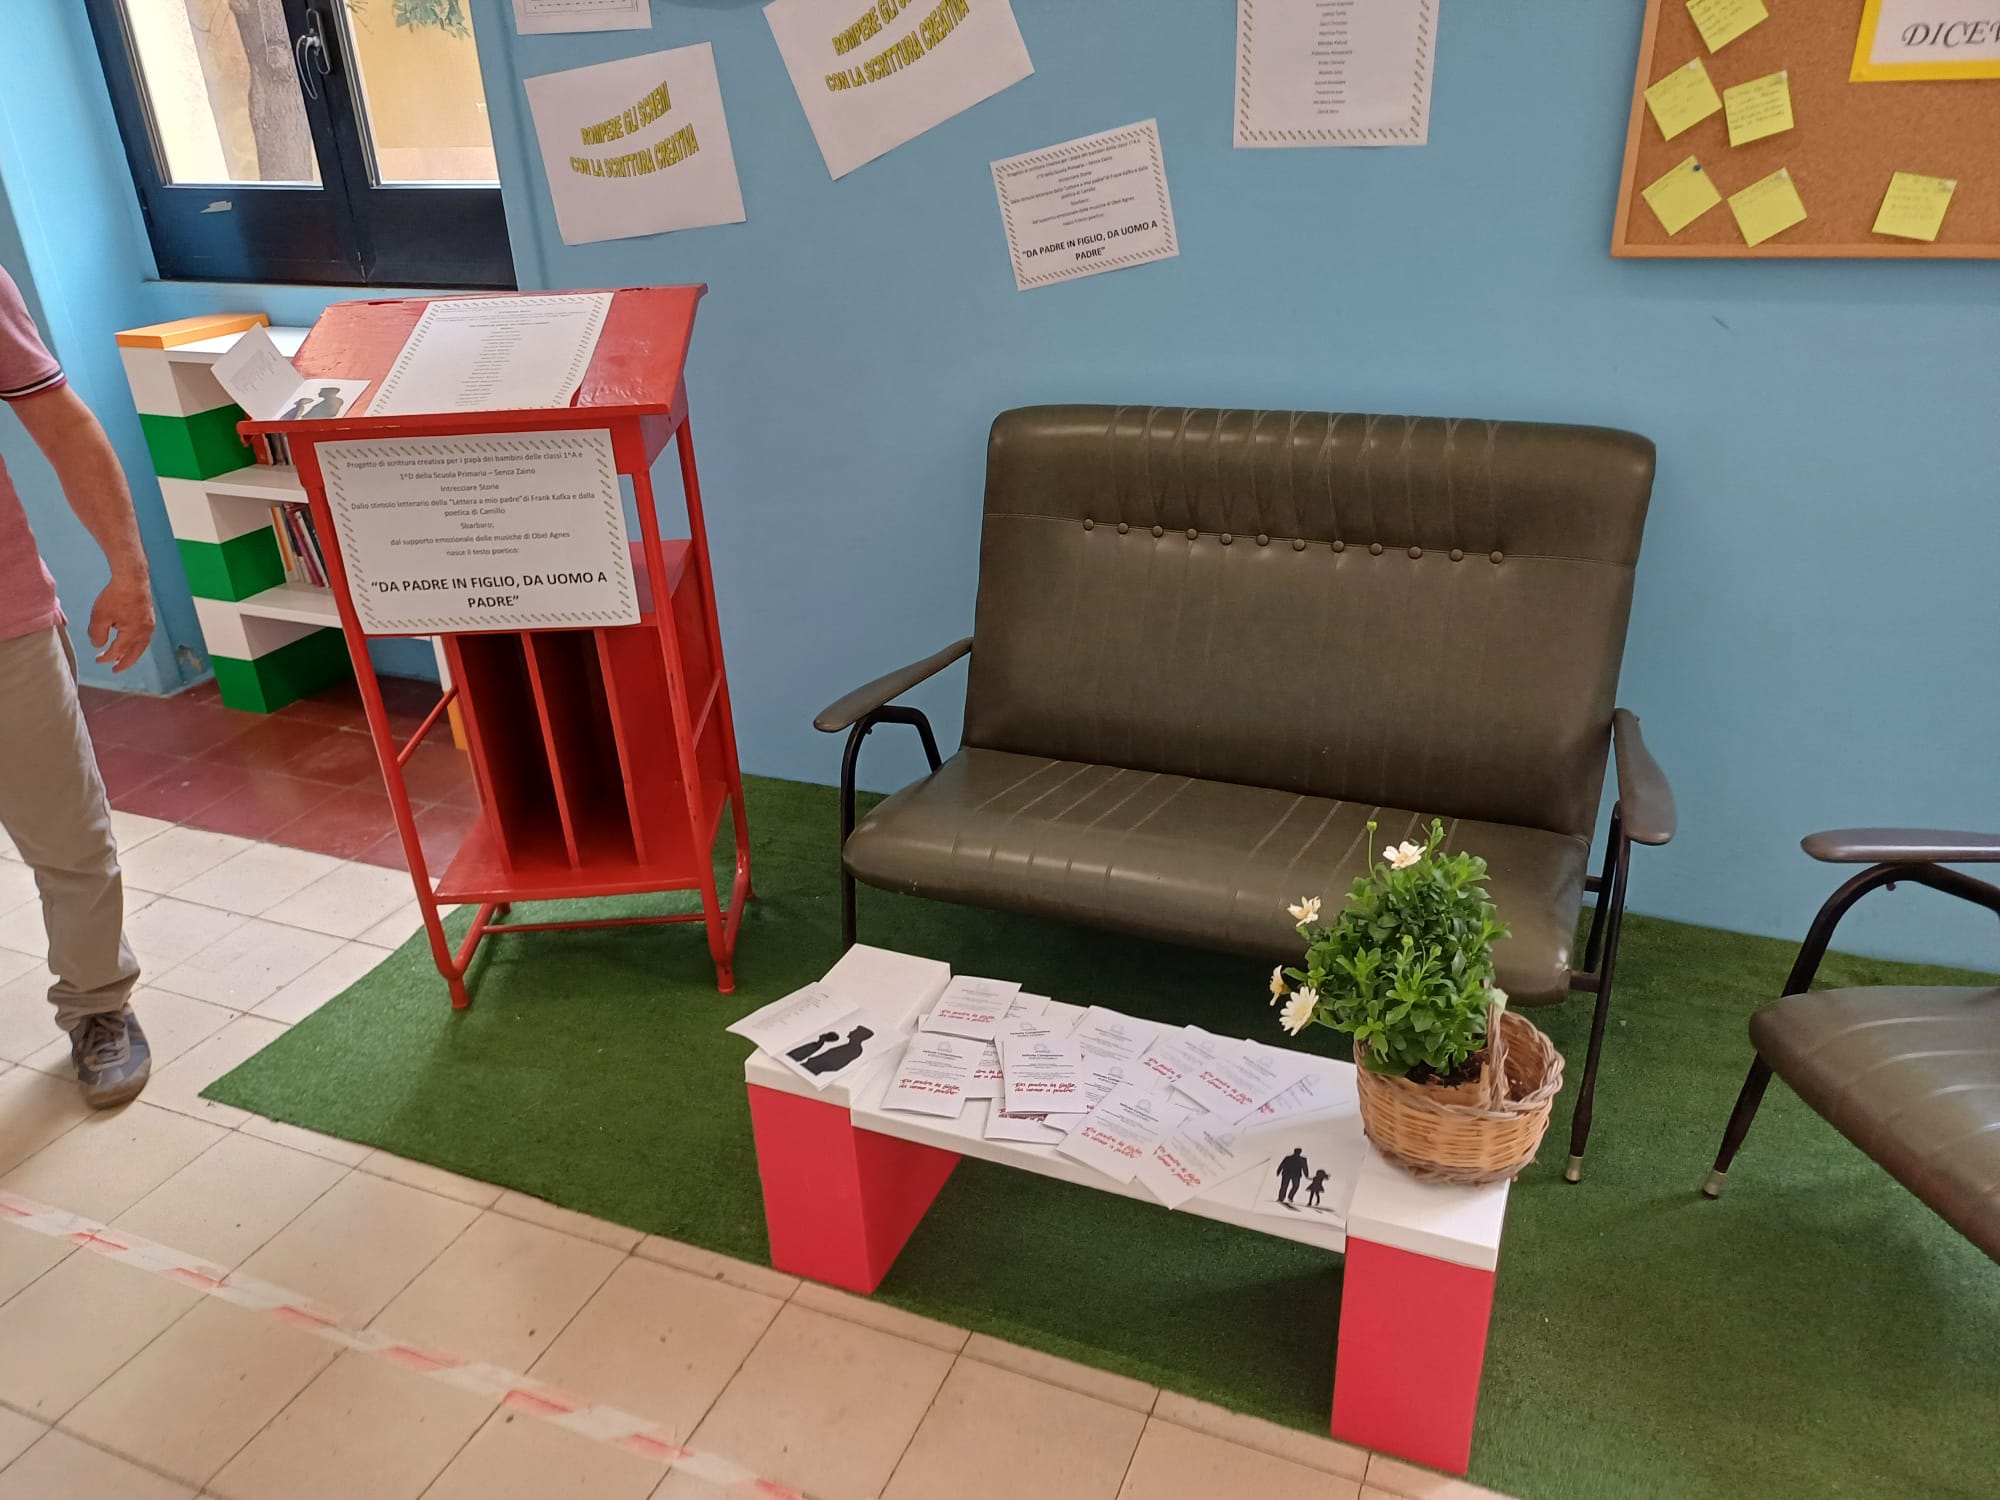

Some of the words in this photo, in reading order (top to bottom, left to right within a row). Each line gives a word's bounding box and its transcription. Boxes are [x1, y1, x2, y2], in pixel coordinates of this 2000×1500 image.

[832, 6, 882, 56] ROMPERE
[825, 71, 850, 91] CON
[847, 66, 867, 87] LA
[863, 30, 925, 83] SCRITTURA
[580, 115, 624, 145] ROMPERE
[622, 106, 639, 135] GLI
[637, 80, 672, 127] SCHEMI
[569, 156, 592, 175] CON
[590, 158, 605, 177] LA
[604, 148, 656, 178] SCRITTURA
[653, 123, 700, 170] CREATIVA
[1022, 248, 1038, 258] “DA
[1039, 241, 1065, 255] PADRE
[1066, 239, 1076, 249] IN
[1076, 232, 1106, 247] FIGLIO,
[1106, 229, 1120, 239] DA
[1120, 222, 1150, 236] UOMO
[1150, 220, 1158, 228] A
[1075, 246, 1106, 261] PADRE”
[346, 461, 377, 470] Progetto
[387, 459, 416, 467] scrittura
[417, 458, 445, 466] creativa
[463, 455, 482, 464] papà
[494, 453, 524, 462] bambini
[433, 471, 456, 479] Scuola
[457, 470, 487, 478] Primaria
[515, 467, 536, 475] Zaino
[478, 483, 500, 491] Storie
[370, 501, 396, 509] stimolo
[397, 499, 430, 508] letterario
[551, 493, 571, 501] Kafka
[444, 509, 471, 517] poetica
[479, 507, 506, 515] Camillo
[402, 538, 434, 546] supporto
[494, 533, 522, 541] musiche
[549, 531, 571, 540] Agnes
[371, 581, 400, 593] “DA
[402, 578, 449, 591] PADRE
[451, 577, 468, 589] IN
[470, 575, 521, 589] FIGLIO,
[523, 574, 544, 586] DA
[546, 571, 594, 585] UOMO
[597, 571, 608, 582] A
[467, 594, 519, 609] PADRE”
